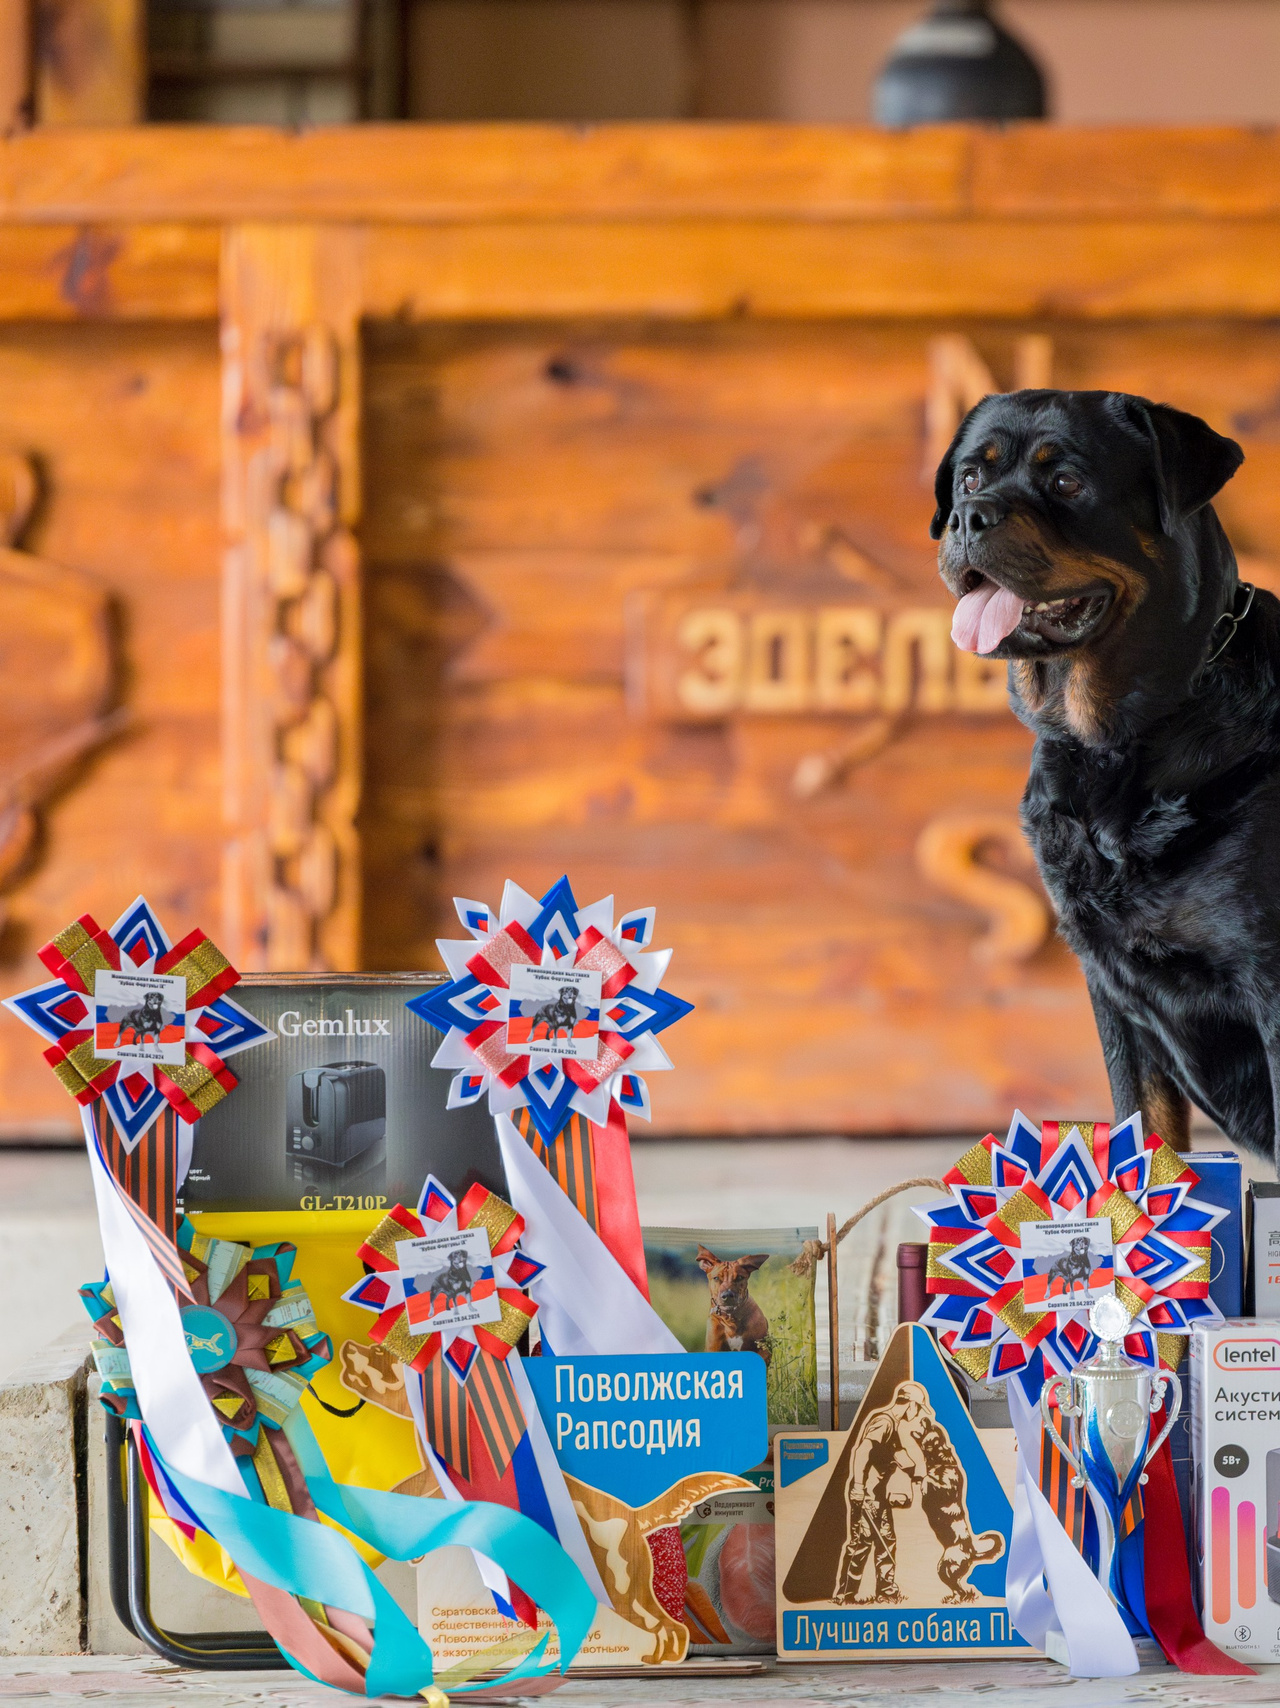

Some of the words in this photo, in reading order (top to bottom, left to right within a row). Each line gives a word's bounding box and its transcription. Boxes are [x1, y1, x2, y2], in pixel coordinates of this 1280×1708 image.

[277, 1009, 391, 1037] Gemlux
[300, 1195, 388, 1212] GL-T210P
[1224, 1346, 1276, 1363] lentel
[555, 1364, 743, 1403] Поволжская
[556, 1412, 701, 1455] Рапсодия
[1222, 1455, 1241, 1465] 5Вт
[432, 1606, 498, 1618] Саратовска
[431, 1620, 513, 1630] общественная
[794, 1615, 889, 1651] Лучшая
[897, 1612, 981, 1642] собака
